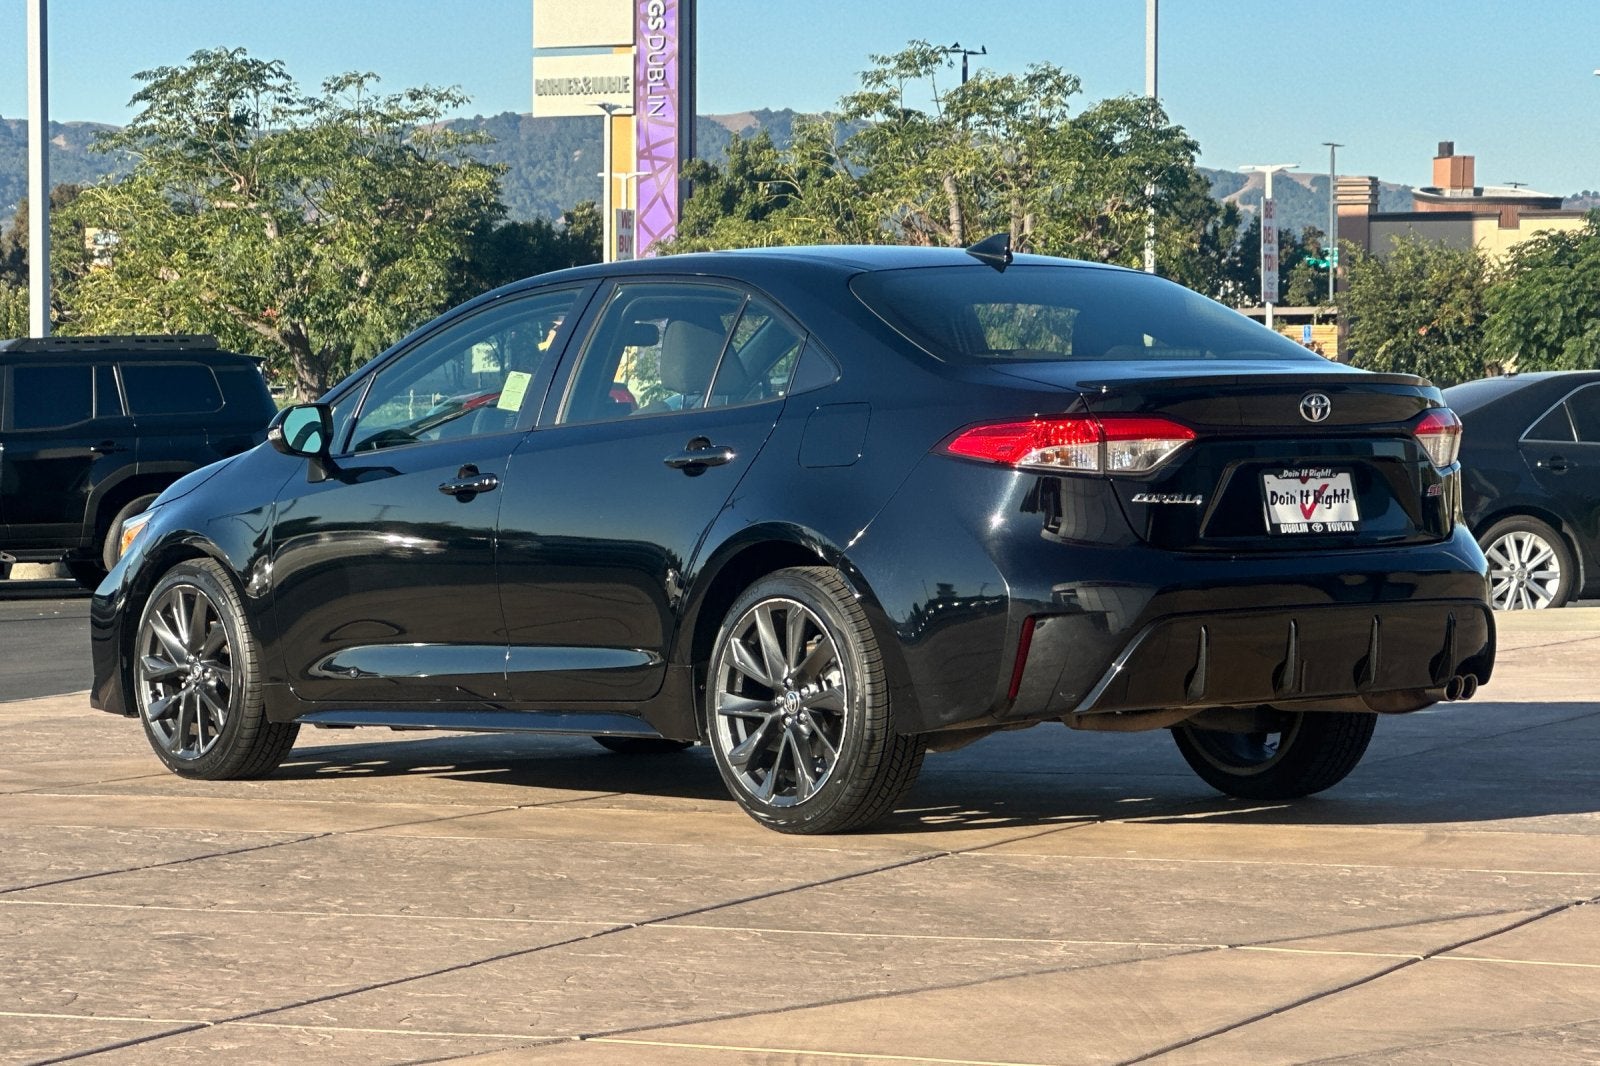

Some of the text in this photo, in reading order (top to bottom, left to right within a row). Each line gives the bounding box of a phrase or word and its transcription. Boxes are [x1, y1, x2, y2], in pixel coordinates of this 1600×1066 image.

[647, 35, 666, 118] DUBLIN
[621, 211, 632, 229] WE
[618, 235, 633, 254] BUY
[1300, 489, 1311, 504] It
[1313, 488, 1350, 510] Right!
[1326, 522, 1355, 532] TOYOTA
